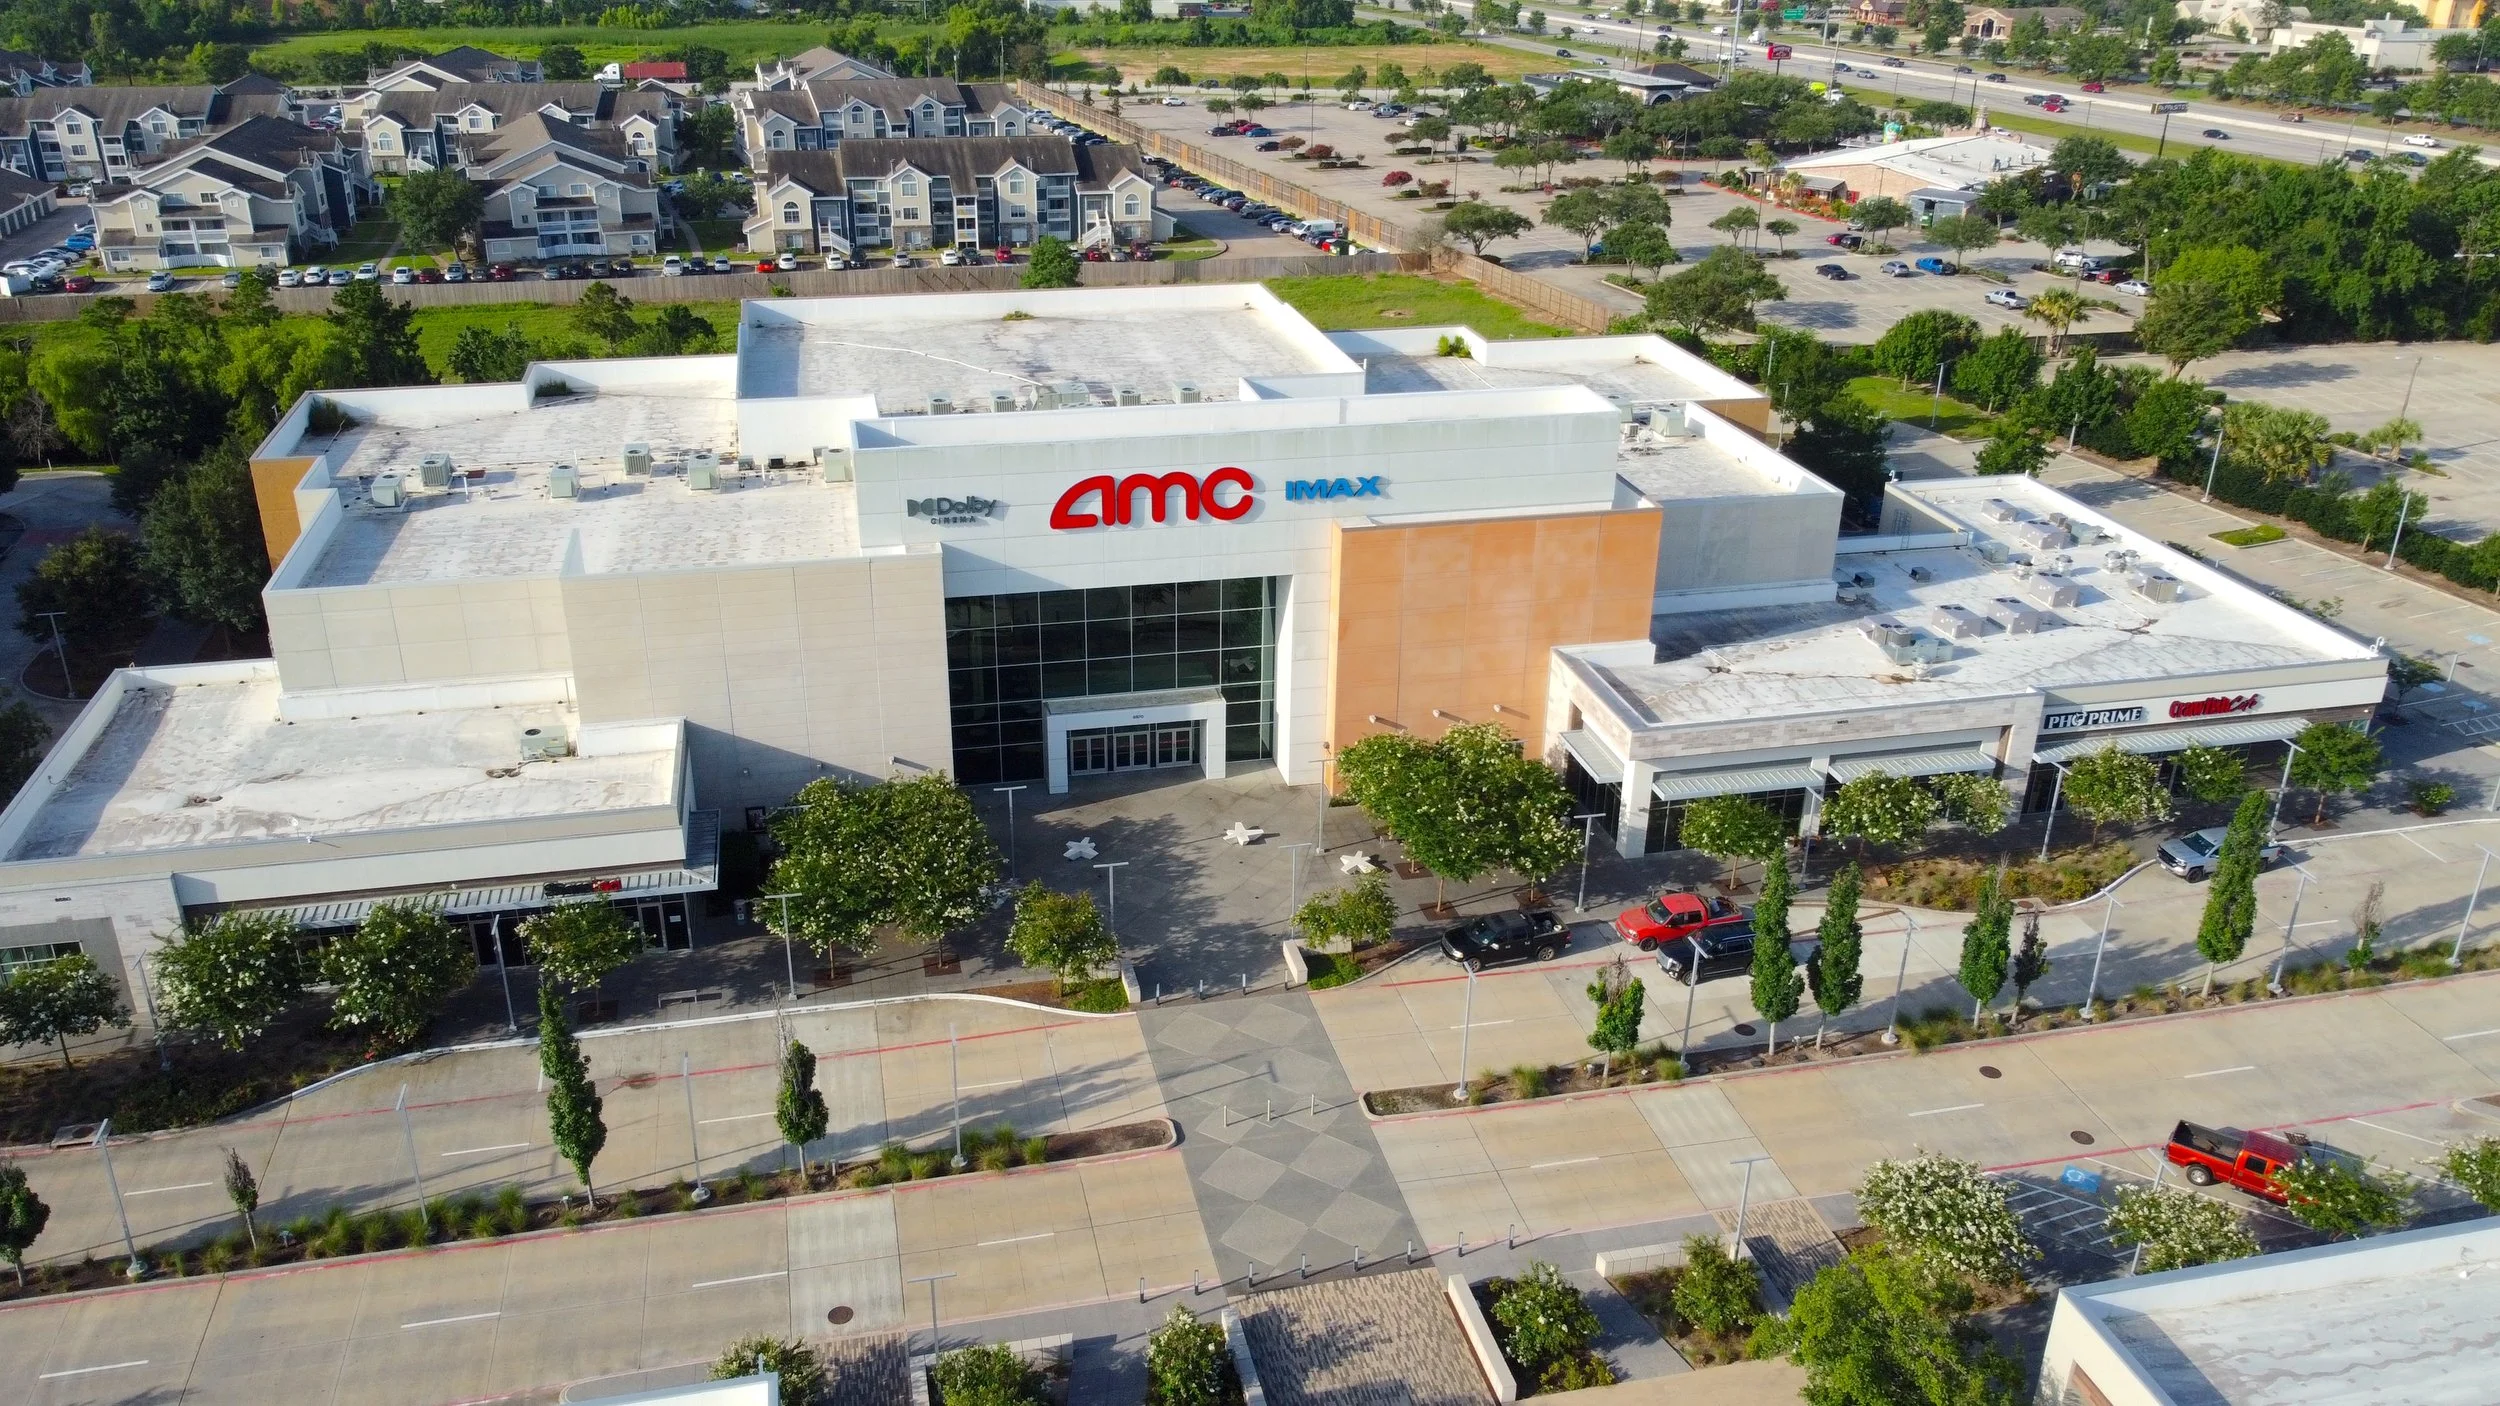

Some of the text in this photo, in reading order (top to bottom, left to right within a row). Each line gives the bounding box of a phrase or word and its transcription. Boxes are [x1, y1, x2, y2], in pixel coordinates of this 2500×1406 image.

[1285, 475, 1381, 501] IMAX
[936, 495, 997, 517] Dolby
[930, 515, 977, 525] CINEMA
[2169, 695, 2231, 718] Crawfish
[2048, 708, 2142, 729] PHO PRIME
